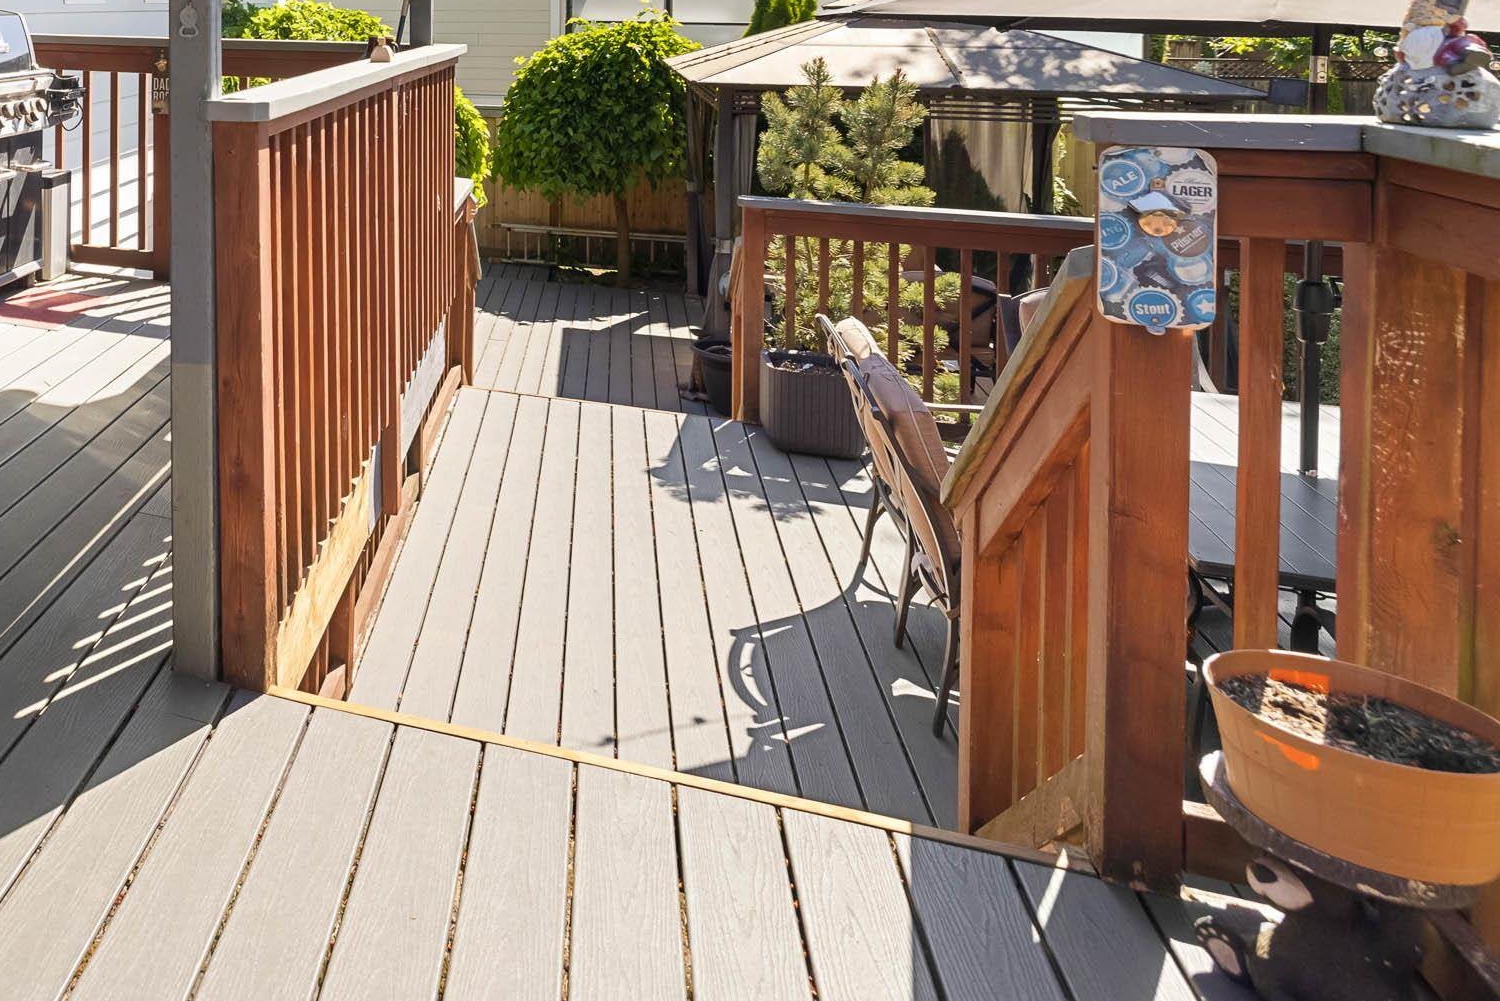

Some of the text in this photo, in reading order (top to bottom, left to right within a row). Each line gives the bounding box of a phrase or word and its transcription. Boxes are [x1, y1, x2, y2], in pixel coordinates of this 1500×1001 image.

[1110, 170, 1139, 190] ALE
[1172, 184, 1213, 198] LAGER
[1170, 225, 1205, 253] Pilsner
[1135, 303, 1171, 315] Stout
